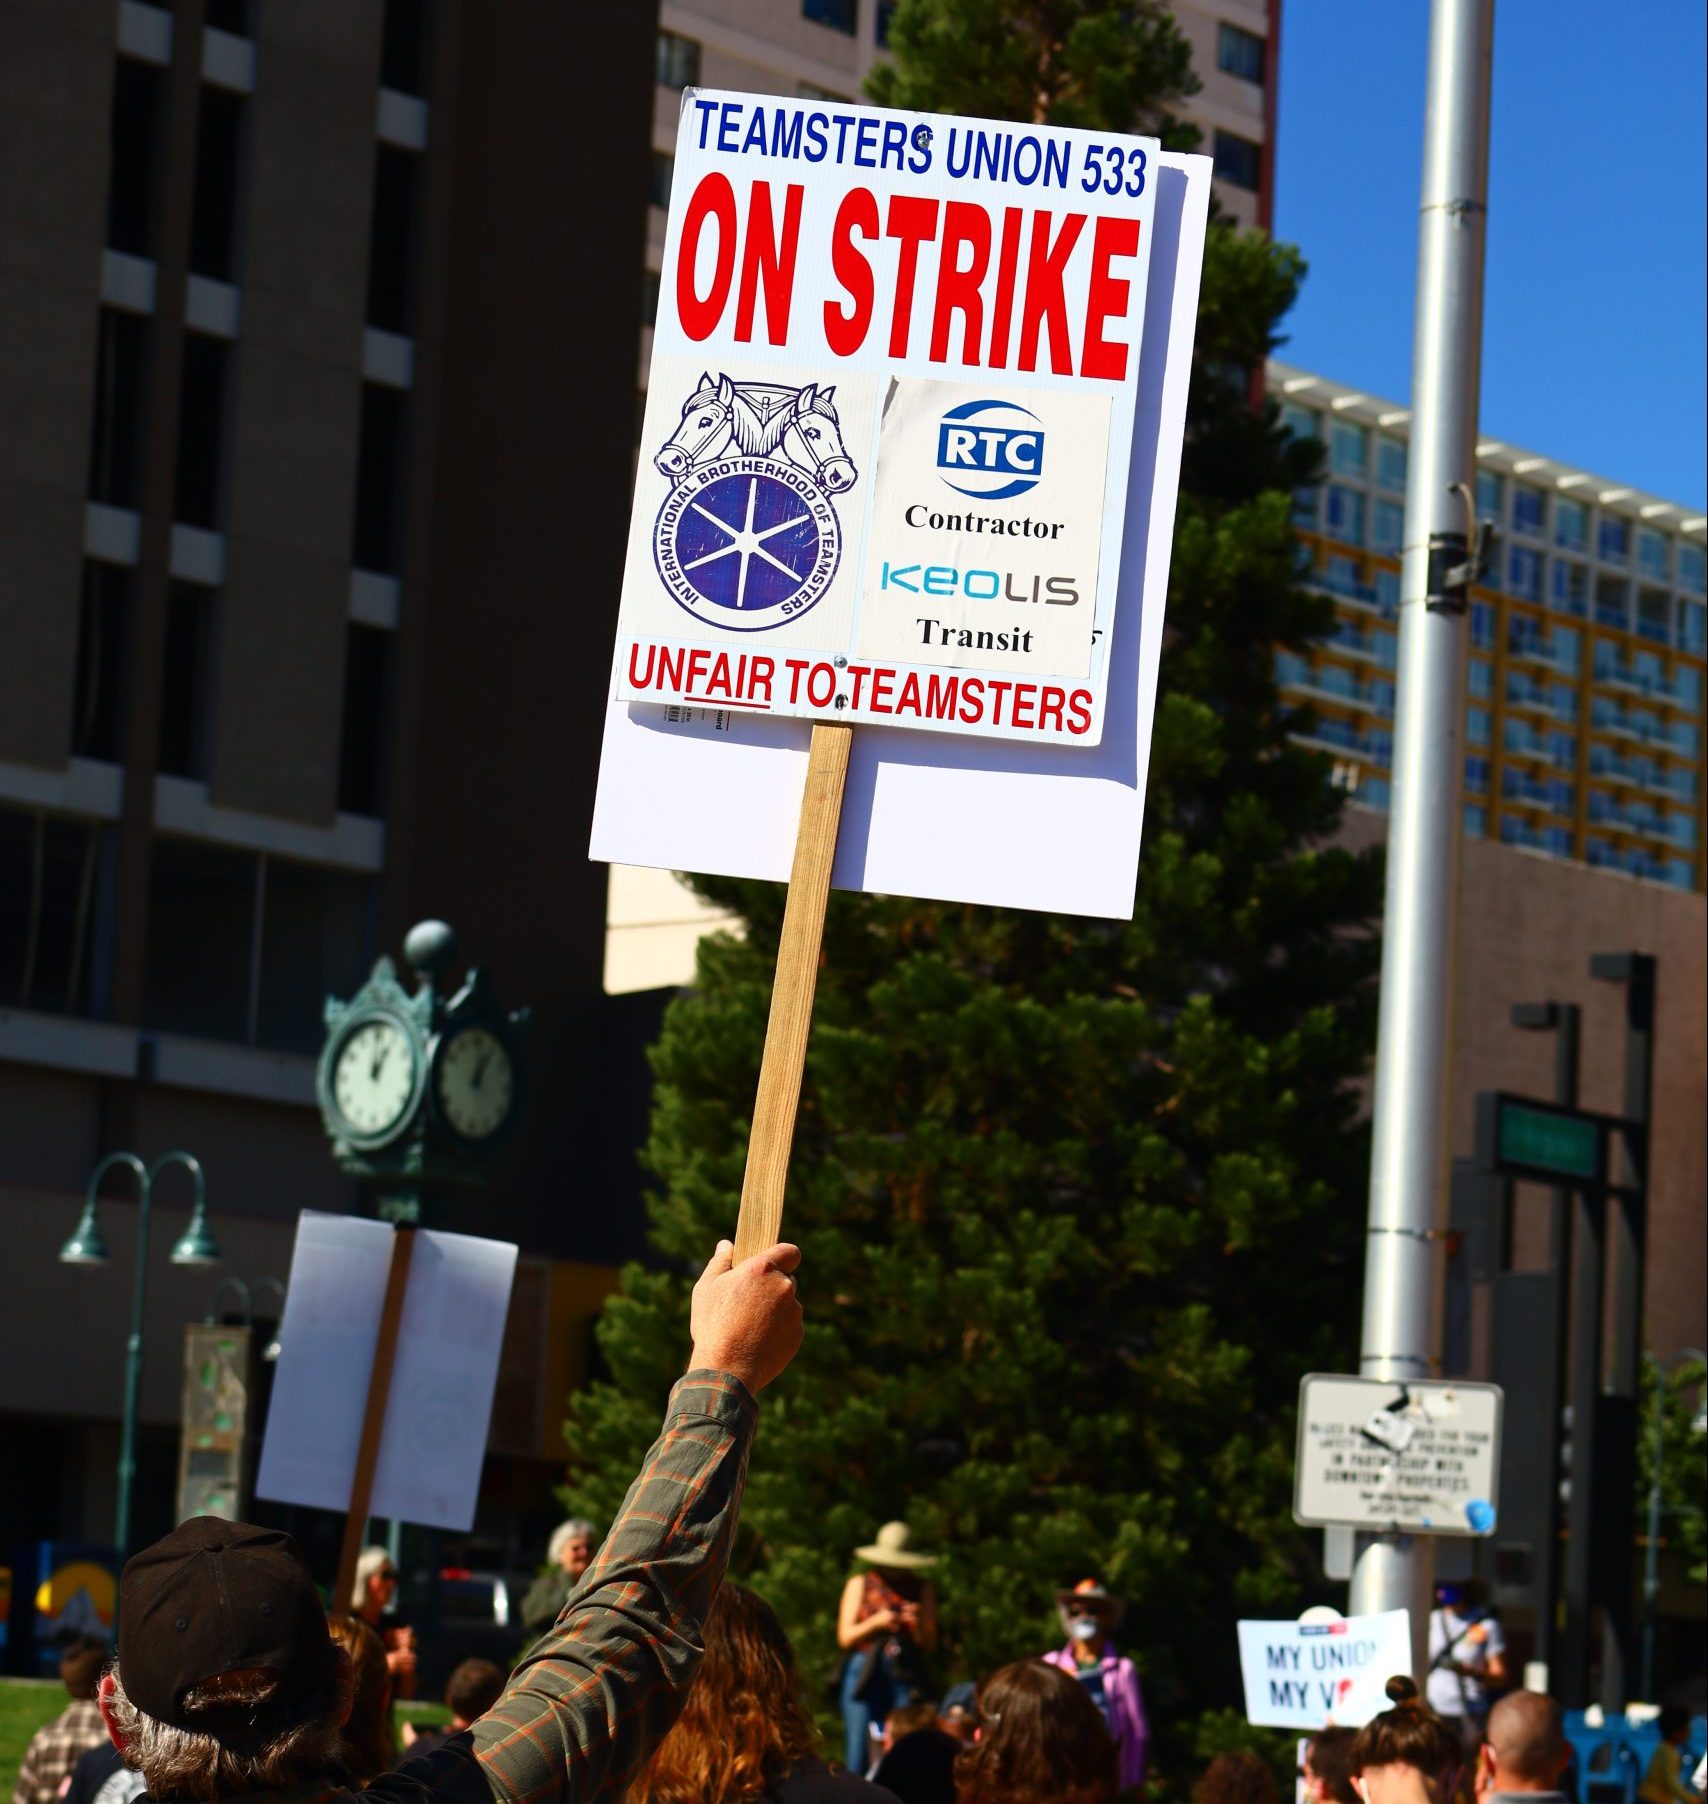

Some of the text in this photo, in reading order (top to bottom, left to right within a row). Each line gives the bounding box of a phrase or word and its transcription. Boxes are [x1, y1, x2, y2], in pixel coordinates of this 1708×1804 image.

[695, 101, 1147, 198] TEAMSTERS UNION 533
[676, 172, 1141, 382] ON STRIKE
[945, 428, 1037, 471] RTC
[660, 460, 835, 615] INTERNATIONAL BROTHERHOOD OF TEAMSTERS
[905, 504, 1065, 540] Contractor
[916, 618, 1035, 653] Transit
[628, 643, 1094, 735] UNFAIR TO TEAMSTERS
[715, 709, 724, 731] oard
[1266, 1644, 1301, 1671] MY
[1269, 1679, 1309, 1709] MY
